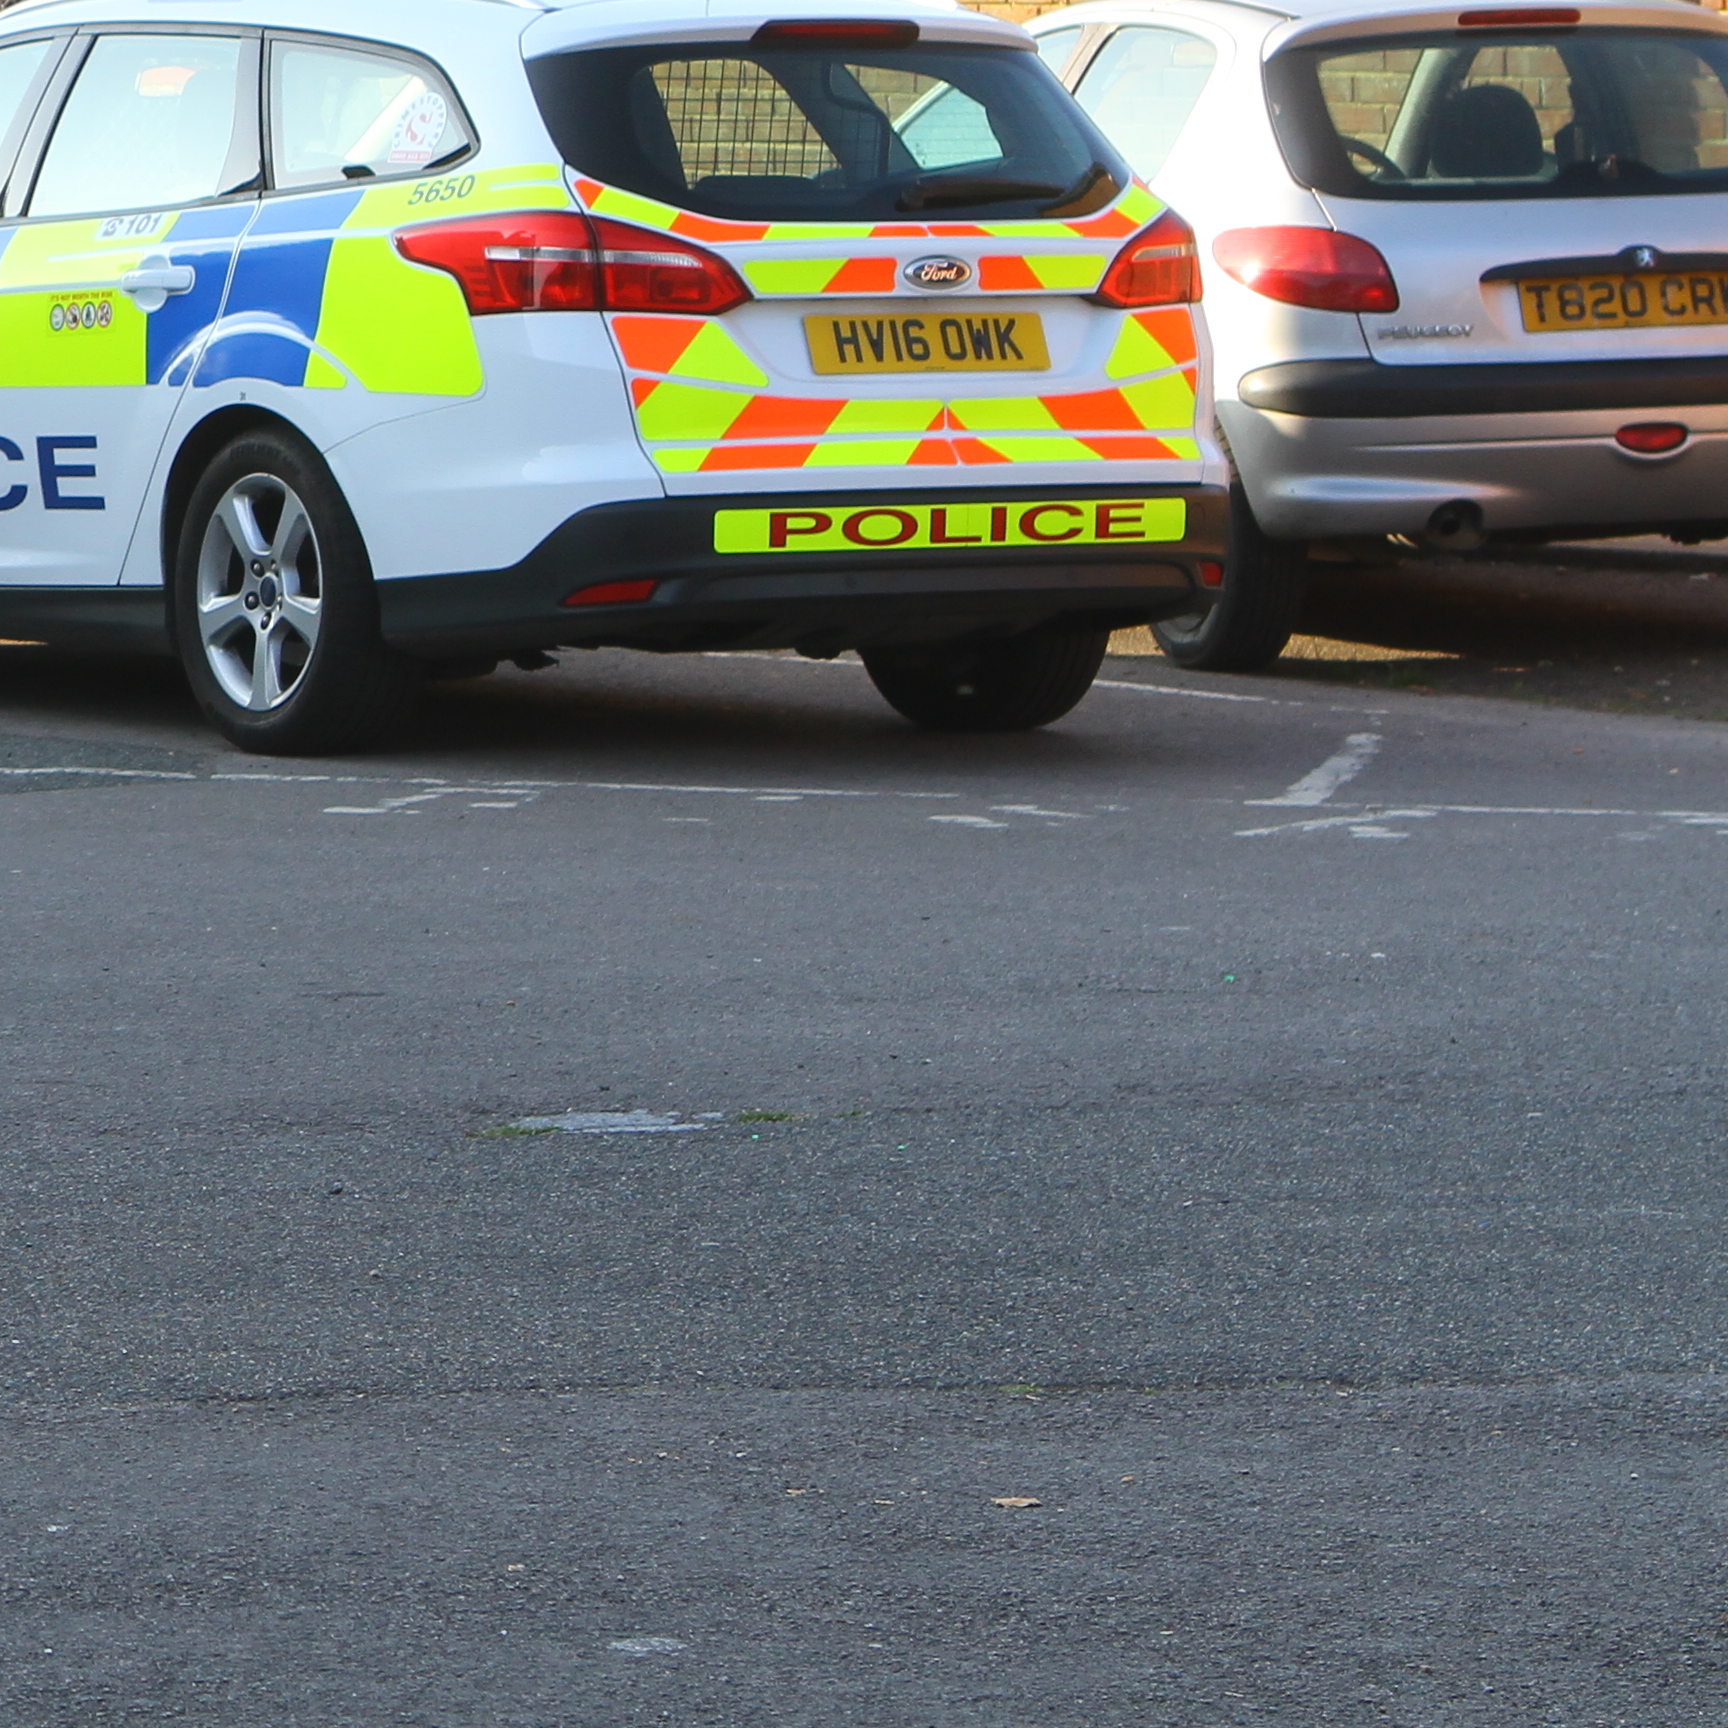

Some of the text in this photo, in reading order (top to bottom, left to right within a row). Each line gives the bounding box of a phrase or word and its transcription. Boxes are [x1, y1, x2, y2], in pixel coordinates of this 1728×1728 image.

[407, 174, 475, 206] 5650
[125, 213, 163, 235] 101
[921, 262, 958, 282] Ford
[1525, 277, 1728, 323] T820 CR
[832, 318, 1024, 363] HV16 OWK
[1377, 325, 1474, 340] PEUGEOT
[768, 502, 1146, 548] POLICE
